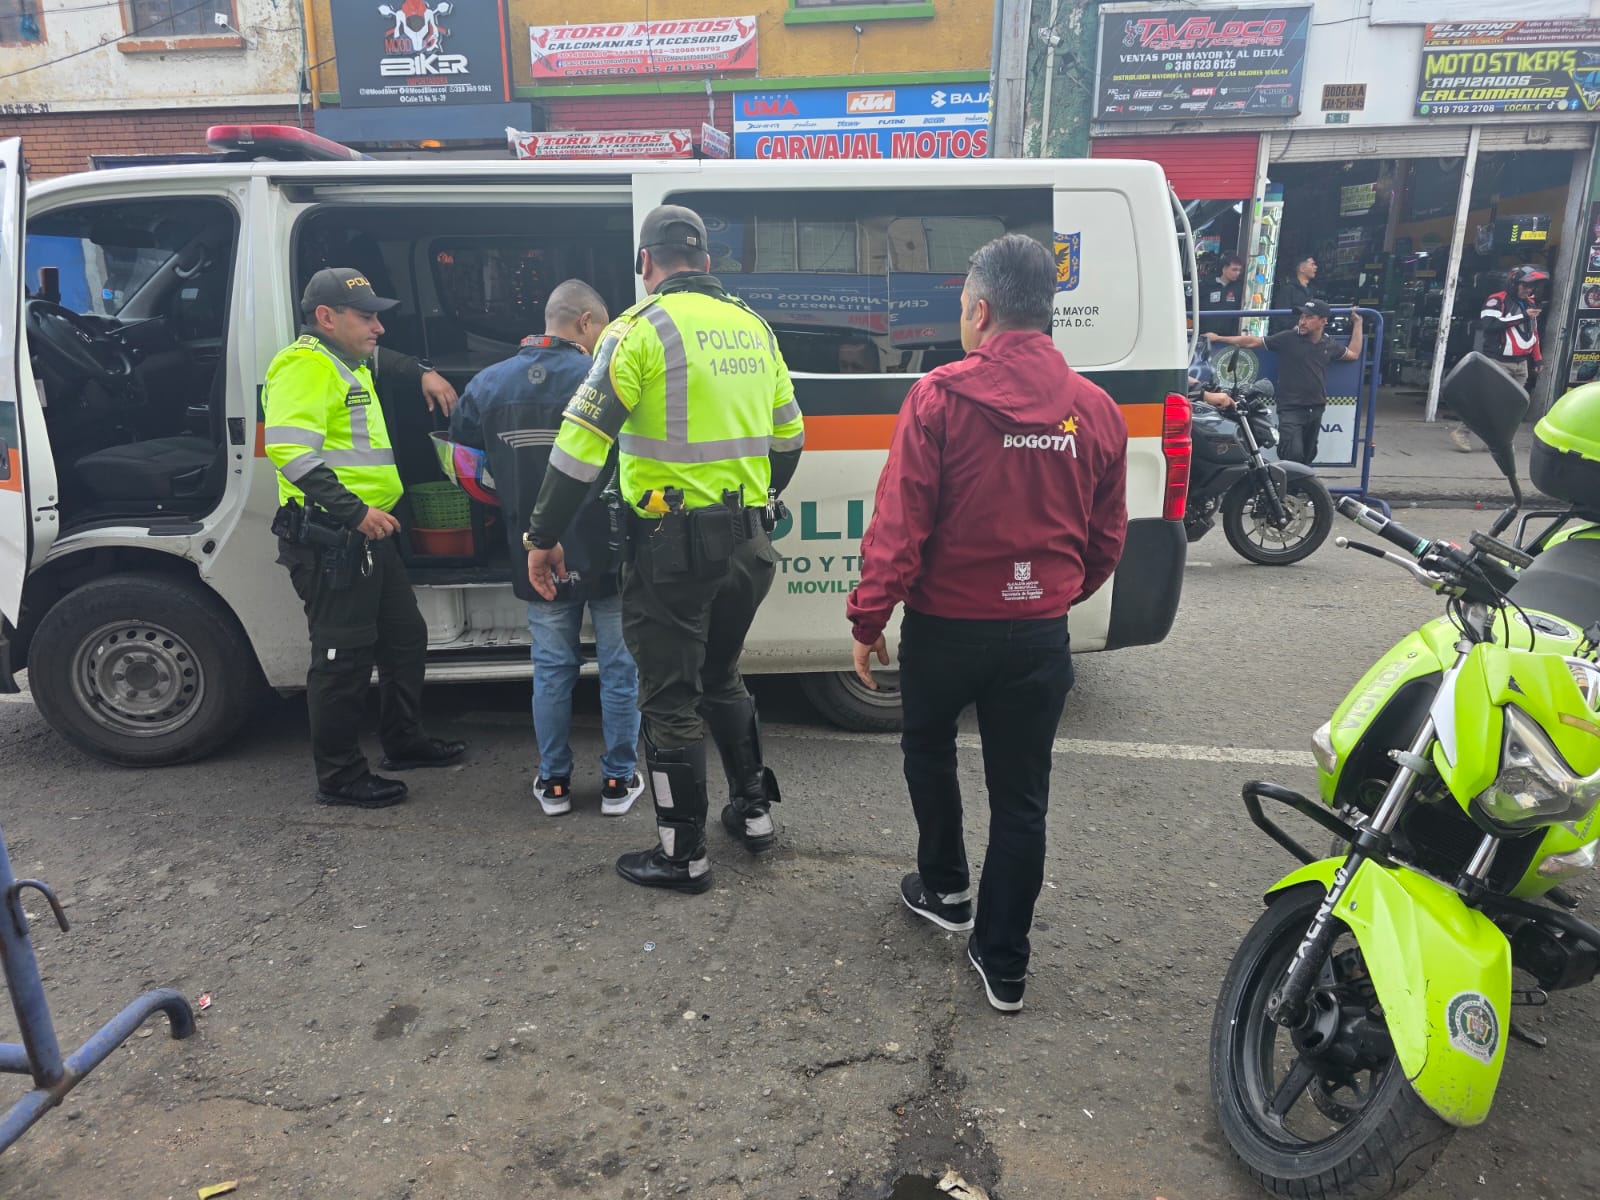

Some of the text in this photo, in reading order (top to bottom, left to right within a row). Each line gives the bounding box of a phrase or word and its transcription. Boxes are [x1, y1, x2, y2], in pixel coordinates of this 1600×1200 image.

[550, 18, 733, 40] TORO MOTOS
[548, 34, 738, 50] CALCOMANIAS Y ACCESORIOS
[1120, 48, 1285, 63] VENTAS POR MAYOR Y AL DETAL
[380, 53, 470, 76] BIKER
[564, 67, 637, 76] CARRERA
[1174, 58, 1237, 71] 318 623 6125
[1431, 75, 1531, 89] TAPIZADOS
[849, 93, 893, 111] KTM
[1420, 87, 1570, 102] CALCOMANIAS
[743, 99, 799, 116] UMA
[1432, 104, 1449, 113] 319
[1452, 104, 1470, 113] 792
[1471, 104, 1495, 113] 2708
[1504, 104, 1531, 112] LOCAL
[543, 134, 664, 145] TORO MOTOS
[756, 132, 882, 159] CARVAJAL
[891, 130, 988, 159] MOTOS
[1063, 306, 1099, 316] MAYOR
[1075, 318, 1095, 328] D.C.
[696, 329, 767, 351] POLICIA
[710, 356, 766, 377] 149091
[597, 392, 607, 405] Y
[819, 556, 835, 572] Y
[1287, 867, 1349, 975] SUZUKI
